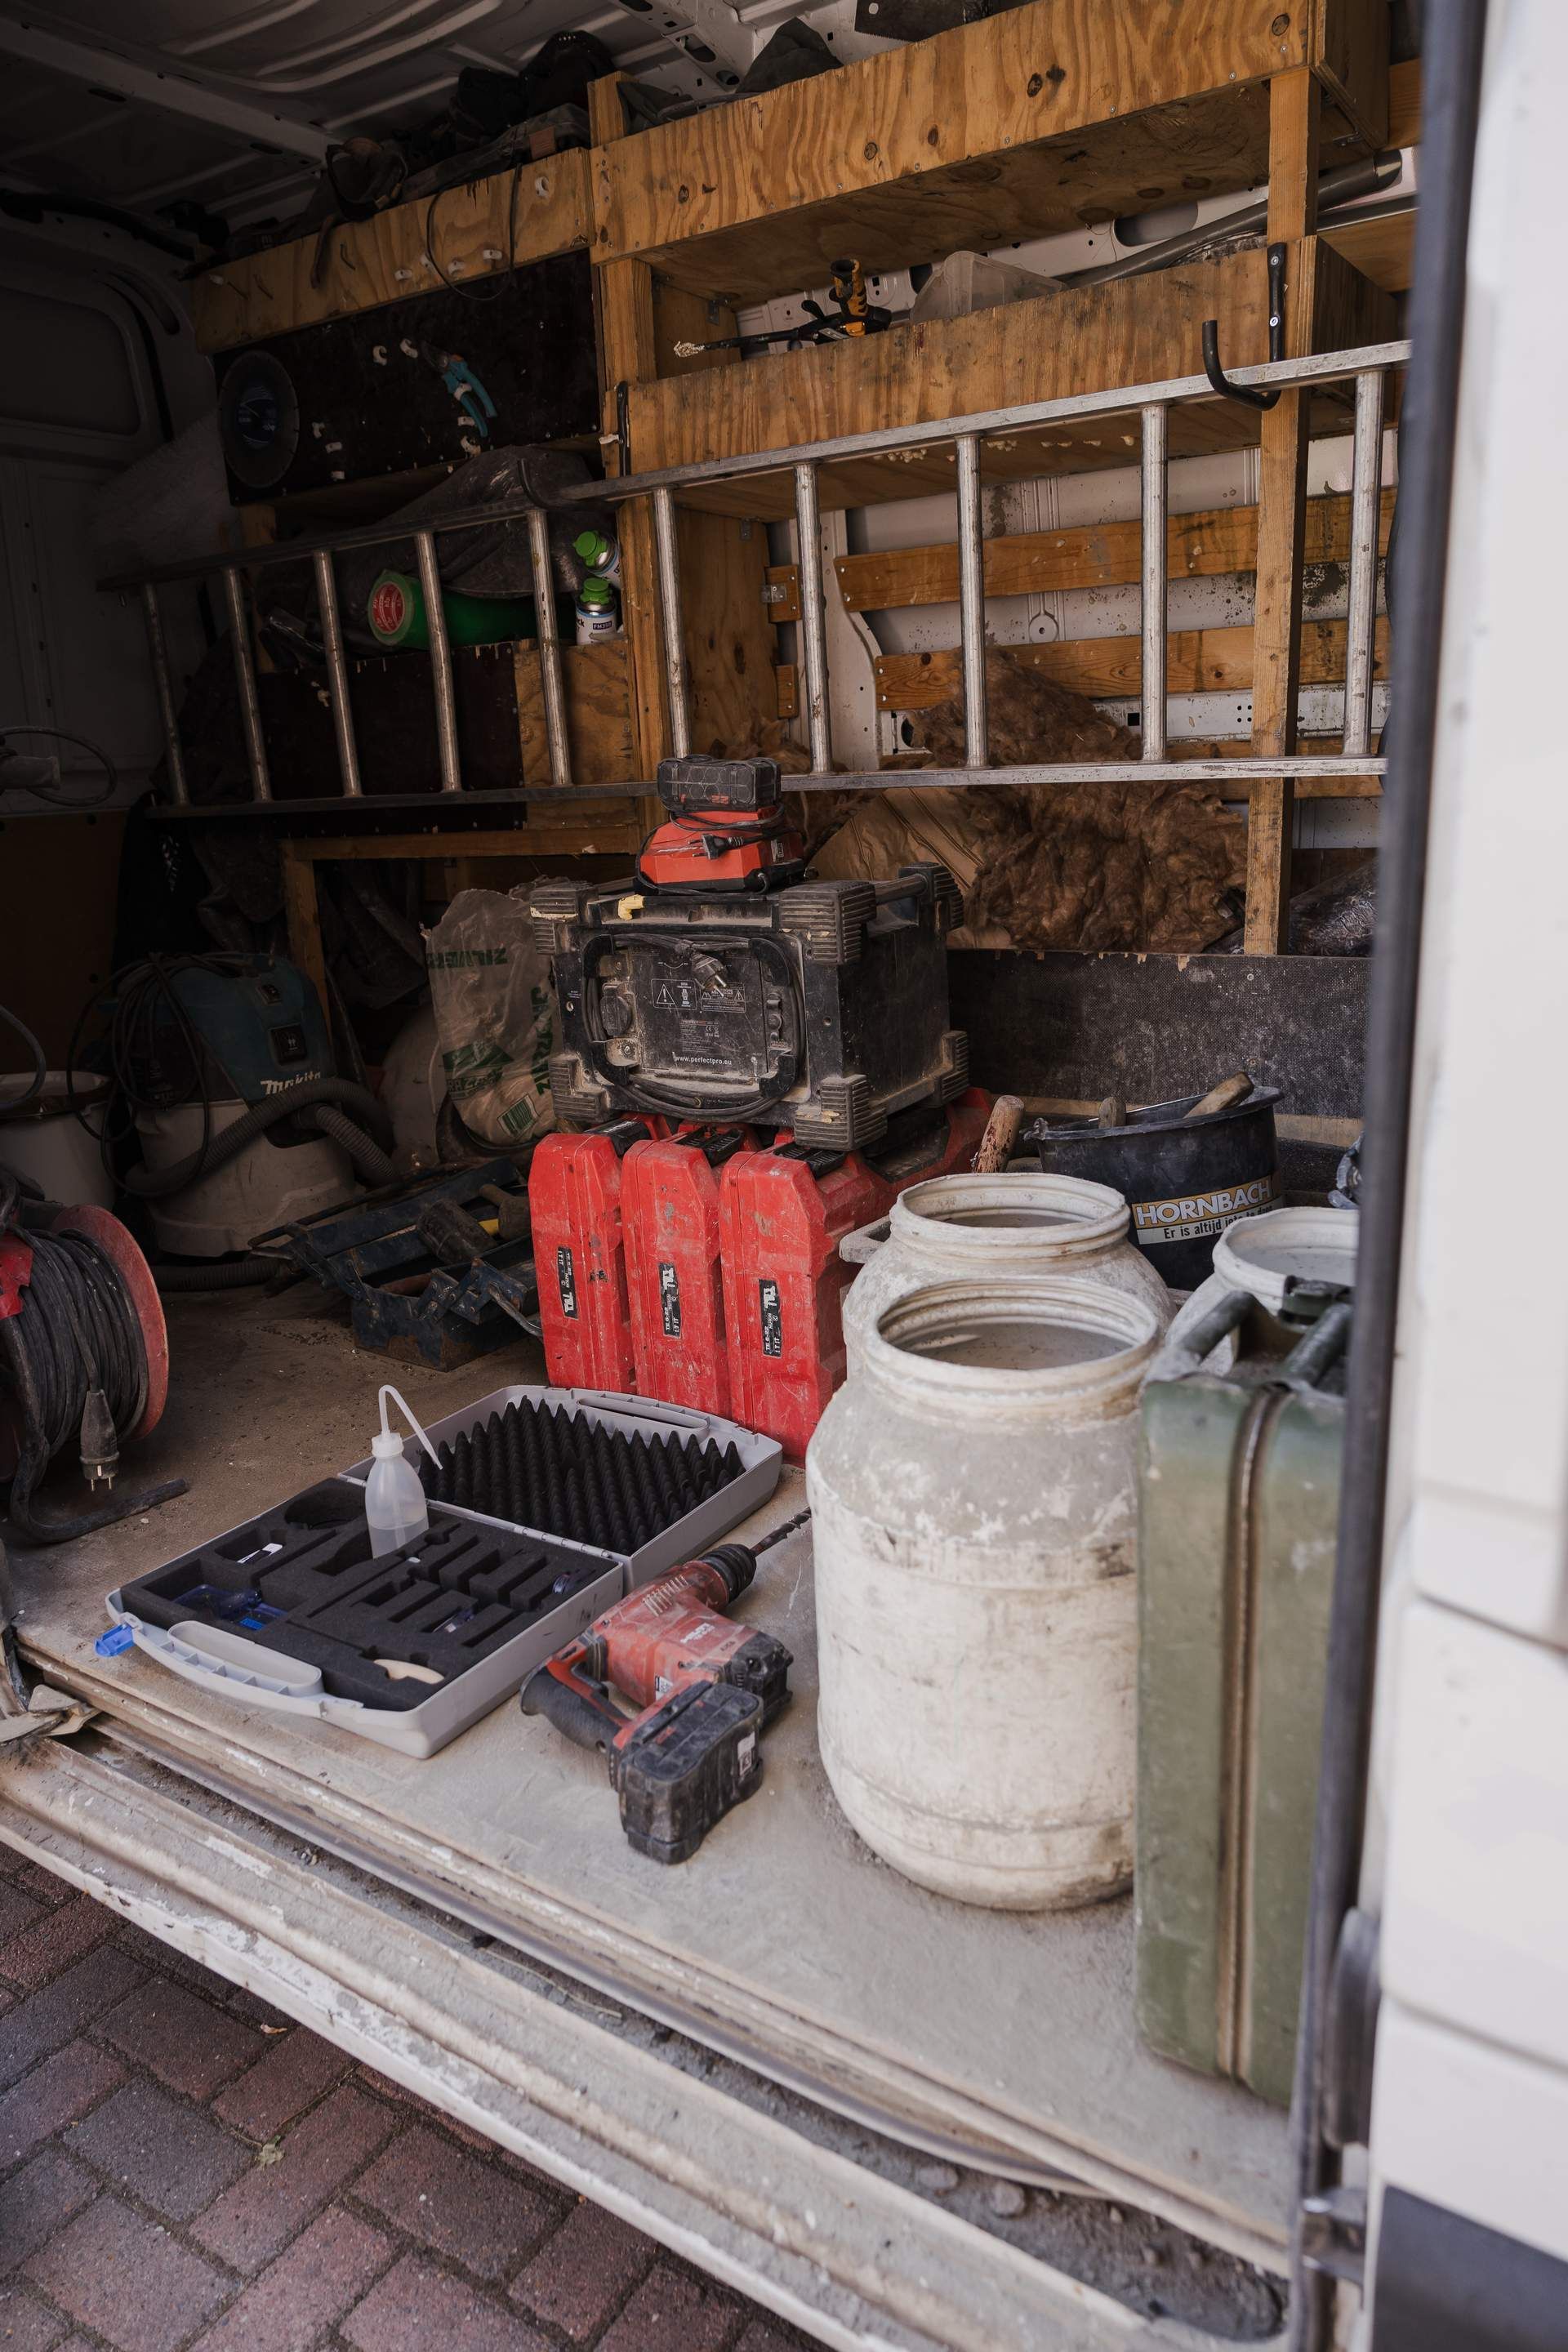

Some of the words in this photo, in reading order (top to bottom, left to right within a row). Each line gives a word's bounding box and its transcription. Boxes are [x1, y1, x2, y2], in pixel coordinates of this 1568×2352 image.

[674, 1056, 733, 1066] www.perfectpro.eu
[1136, 1179, 1272, 1226] HORNBACH
[1164, 1227, 1176, 1239] Er
[1181, 1225, 1191, 1236] is
[1195, 1219, 1222, 1234] altijd
